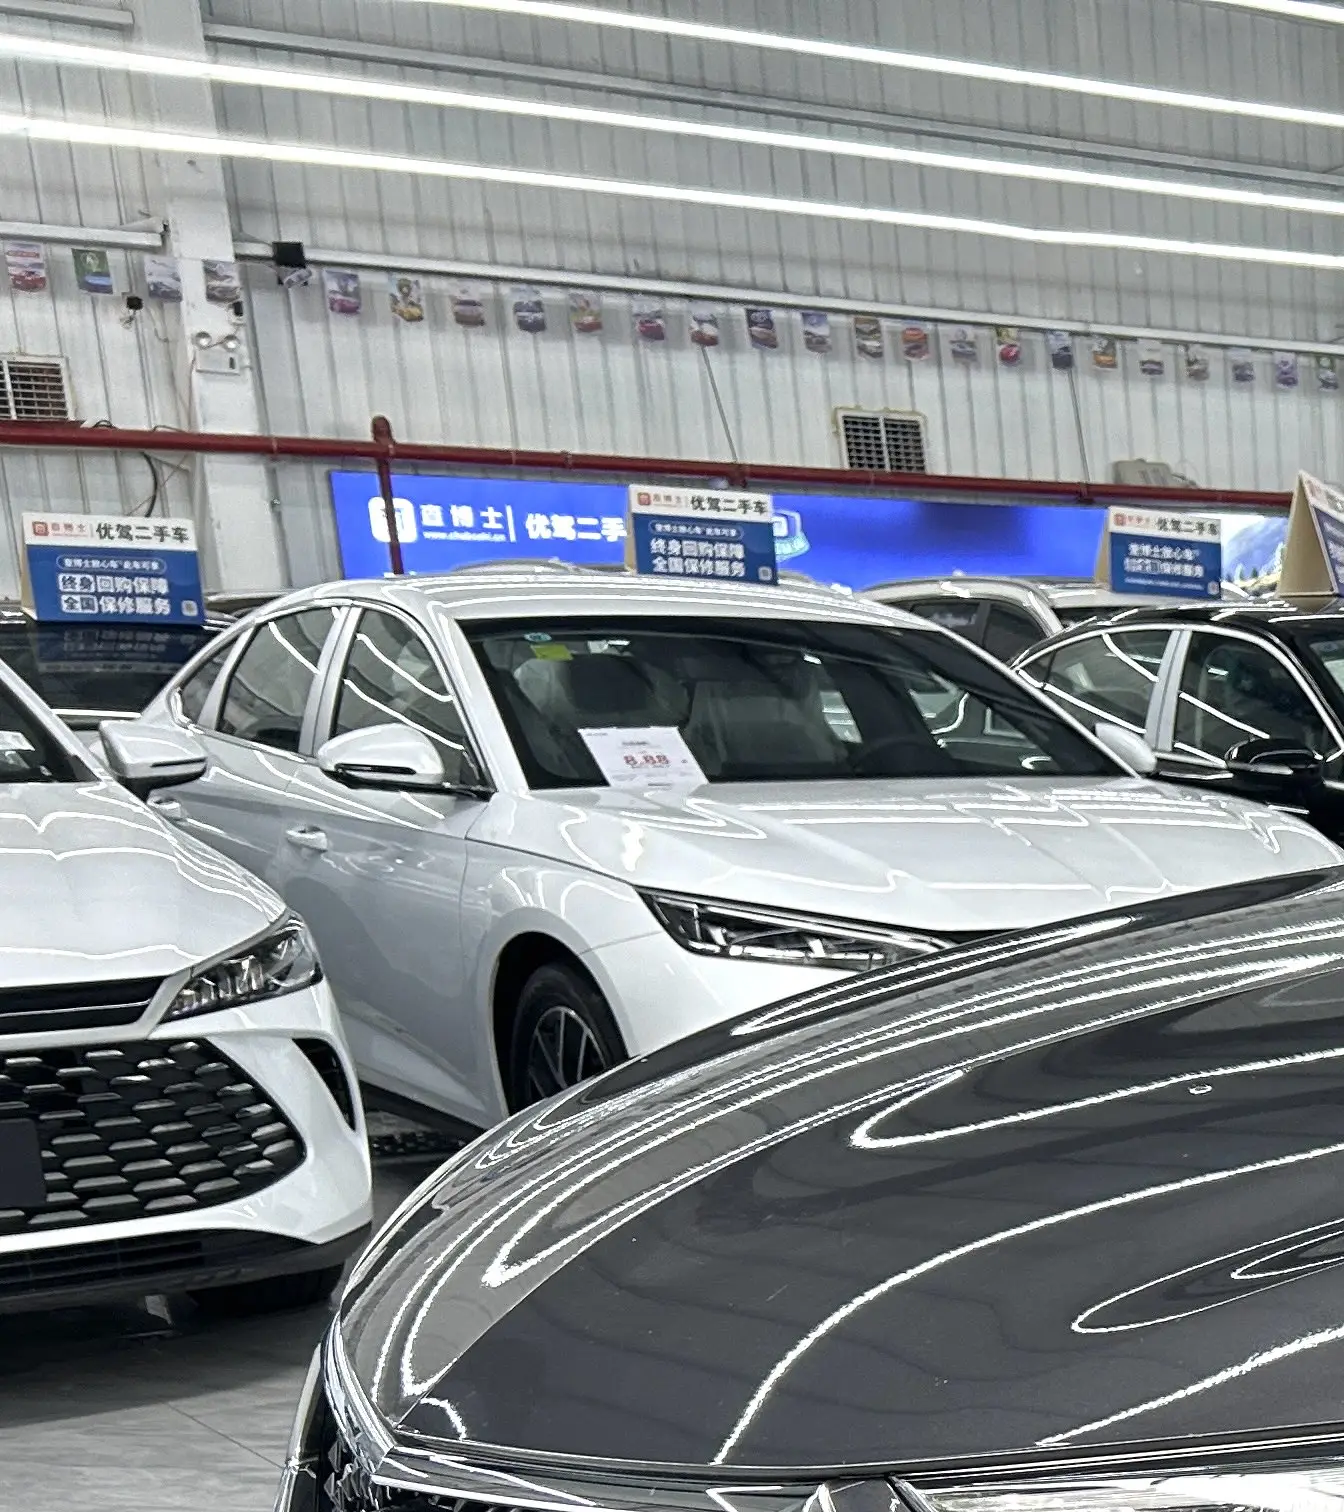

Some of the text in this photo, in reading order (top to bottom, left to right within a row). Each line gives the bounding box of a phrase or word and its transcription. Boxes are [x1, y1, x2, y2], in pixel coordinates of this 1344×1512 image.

[95, 522, 190, 543] 优驾二手车
